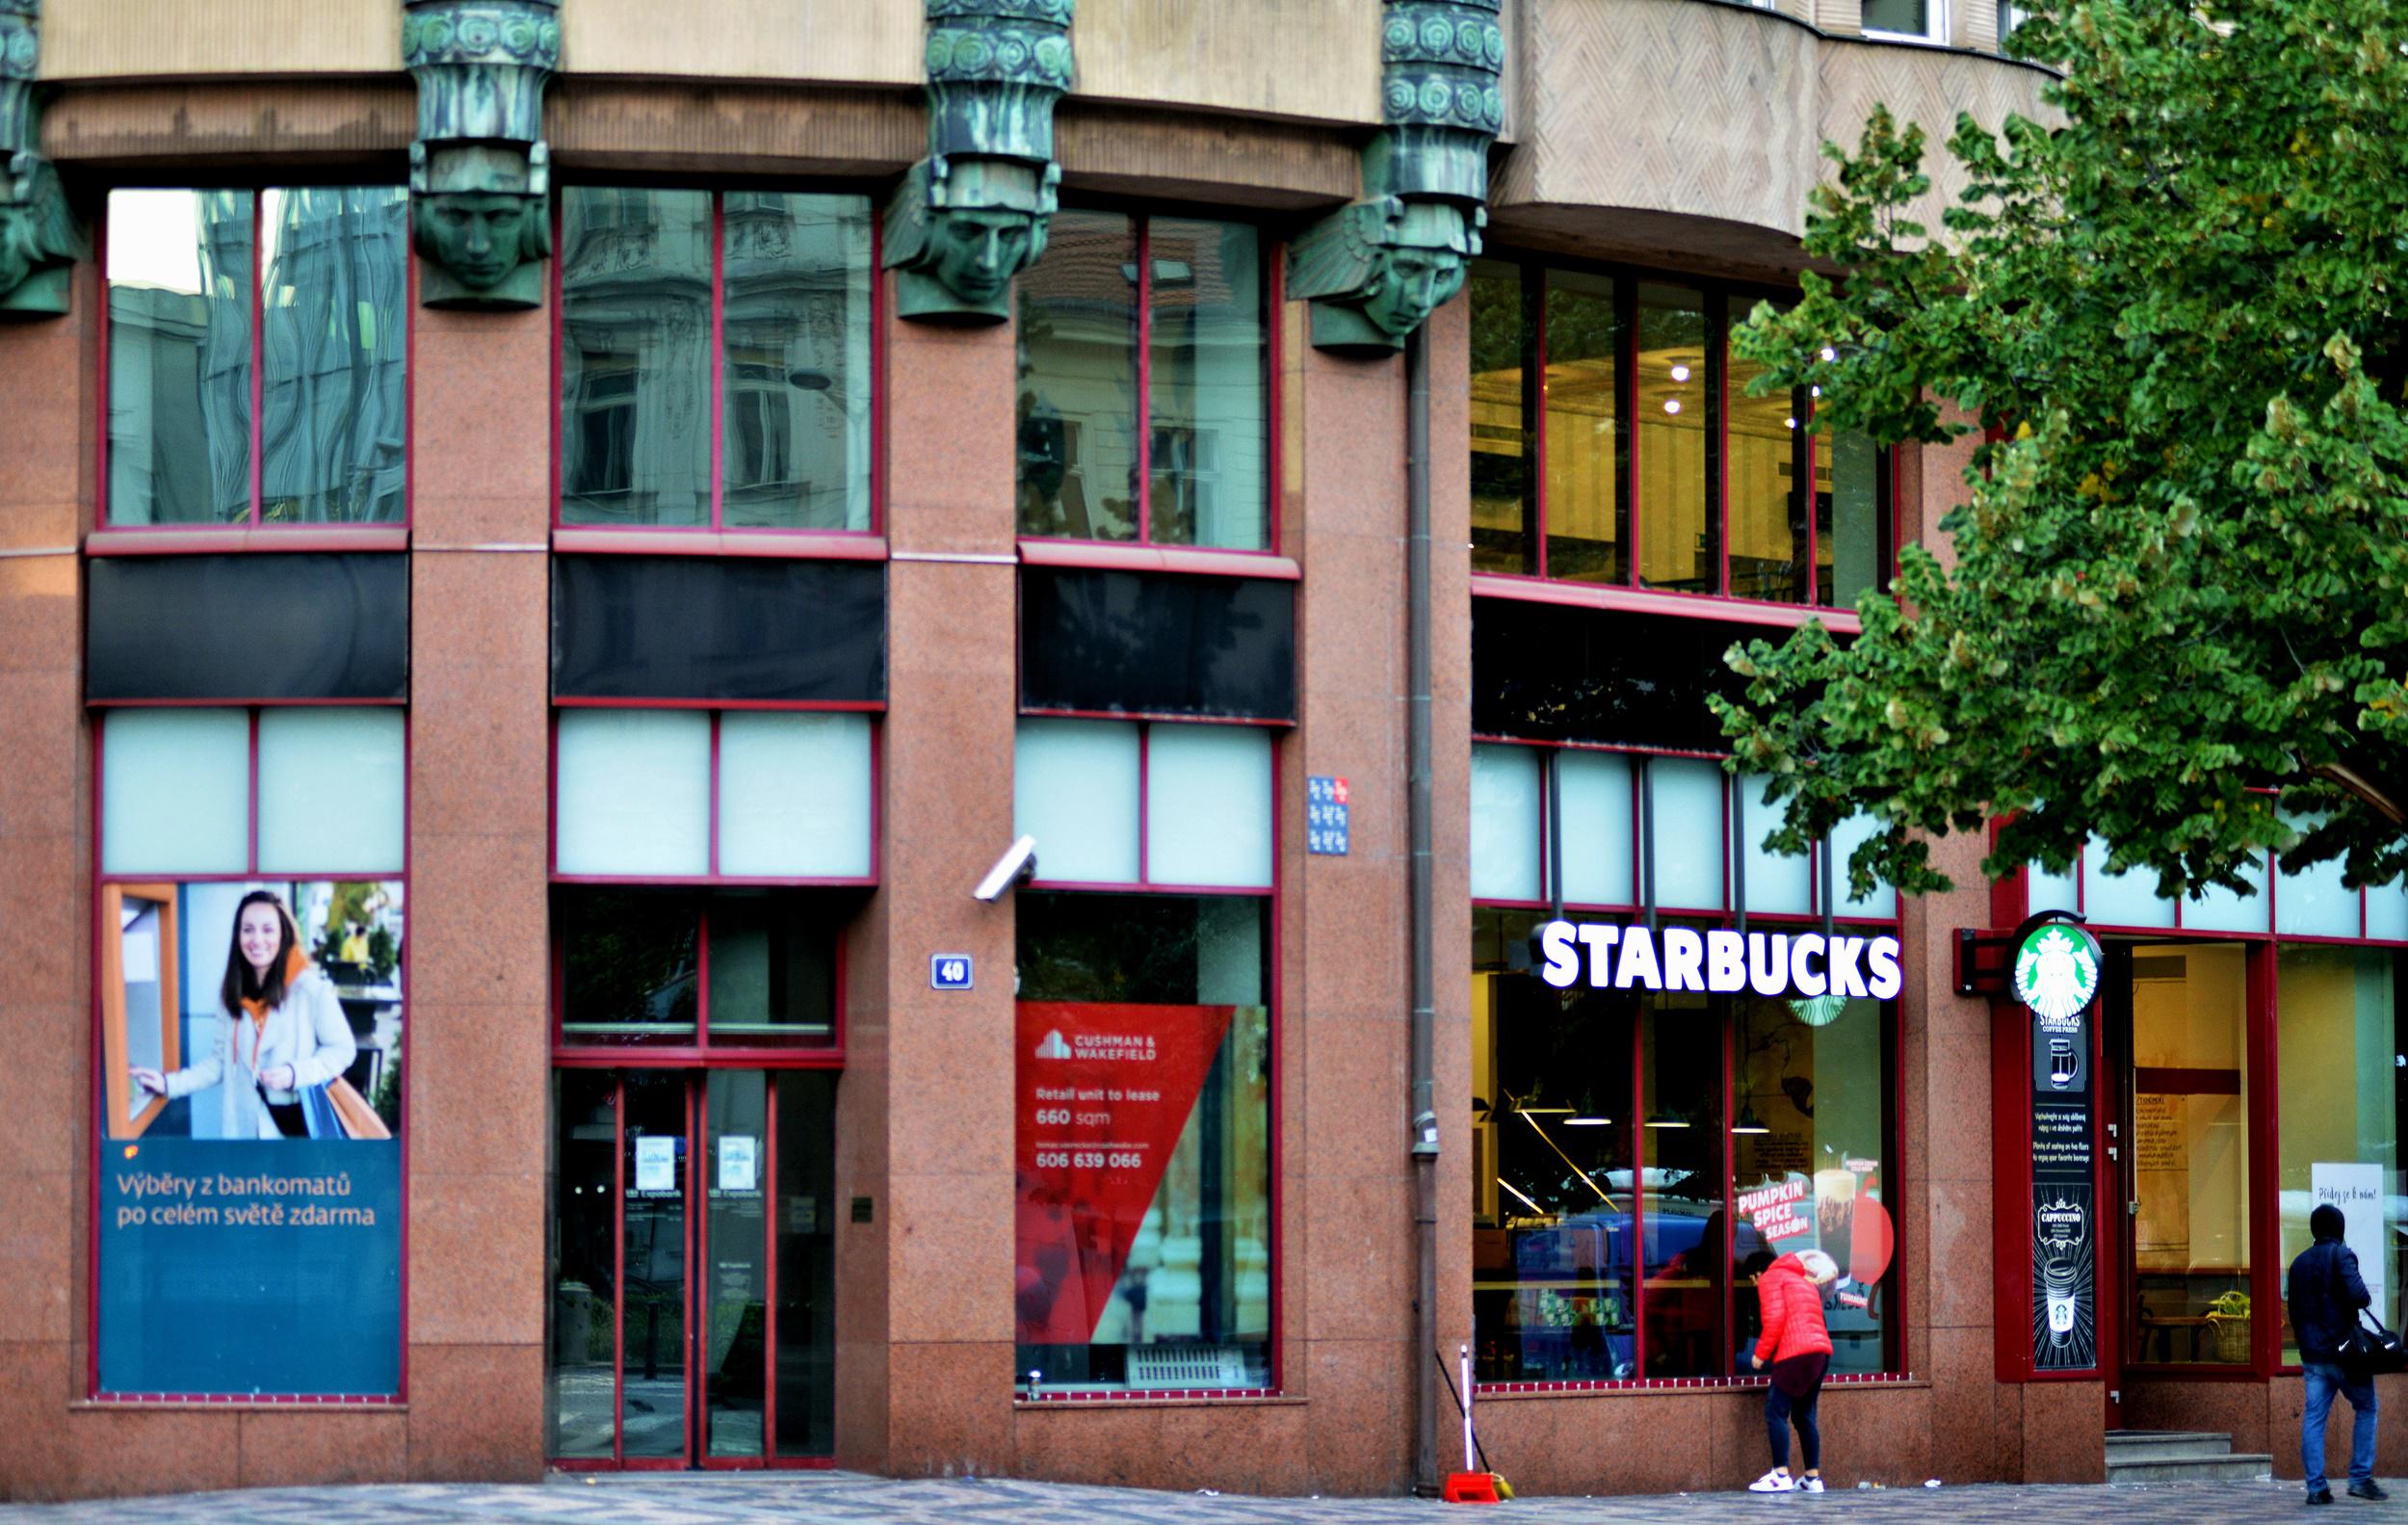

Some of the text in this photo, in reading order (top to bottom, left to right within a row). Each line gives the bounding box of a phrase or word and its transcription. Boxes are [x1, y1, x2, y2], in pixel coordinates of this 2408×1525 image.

[1542, 920, 1902, 1000] STARBUCKS
[941, 960, 964, 982] 40
[1074, 1035, 1156, 1047] CUSHMAN &
[1074, 1048, 1156, 1061] WAKEFIELD
[1035, 1088, 1161, 1101] Retail unit to lease
[1035, 1109, 1111, 1127] 660 sqm
[1035, 1152, 1141, 1169] 606 639 066
[117, 1171, 351, 1200] Výběry z bankomatů
[2359, 1188, 2376, 1200] nám!
[1738, 1180, 1804, 1213] PUMPKIN
[117, 1202, 376, 1230] po celém světě zdarma
[1753, 1202, 1793, 1228] SPICE
[2041, 1213, 2081, 1223] CAPPUCCINO
[1765, 1217, 1809, 1241] SEASON
